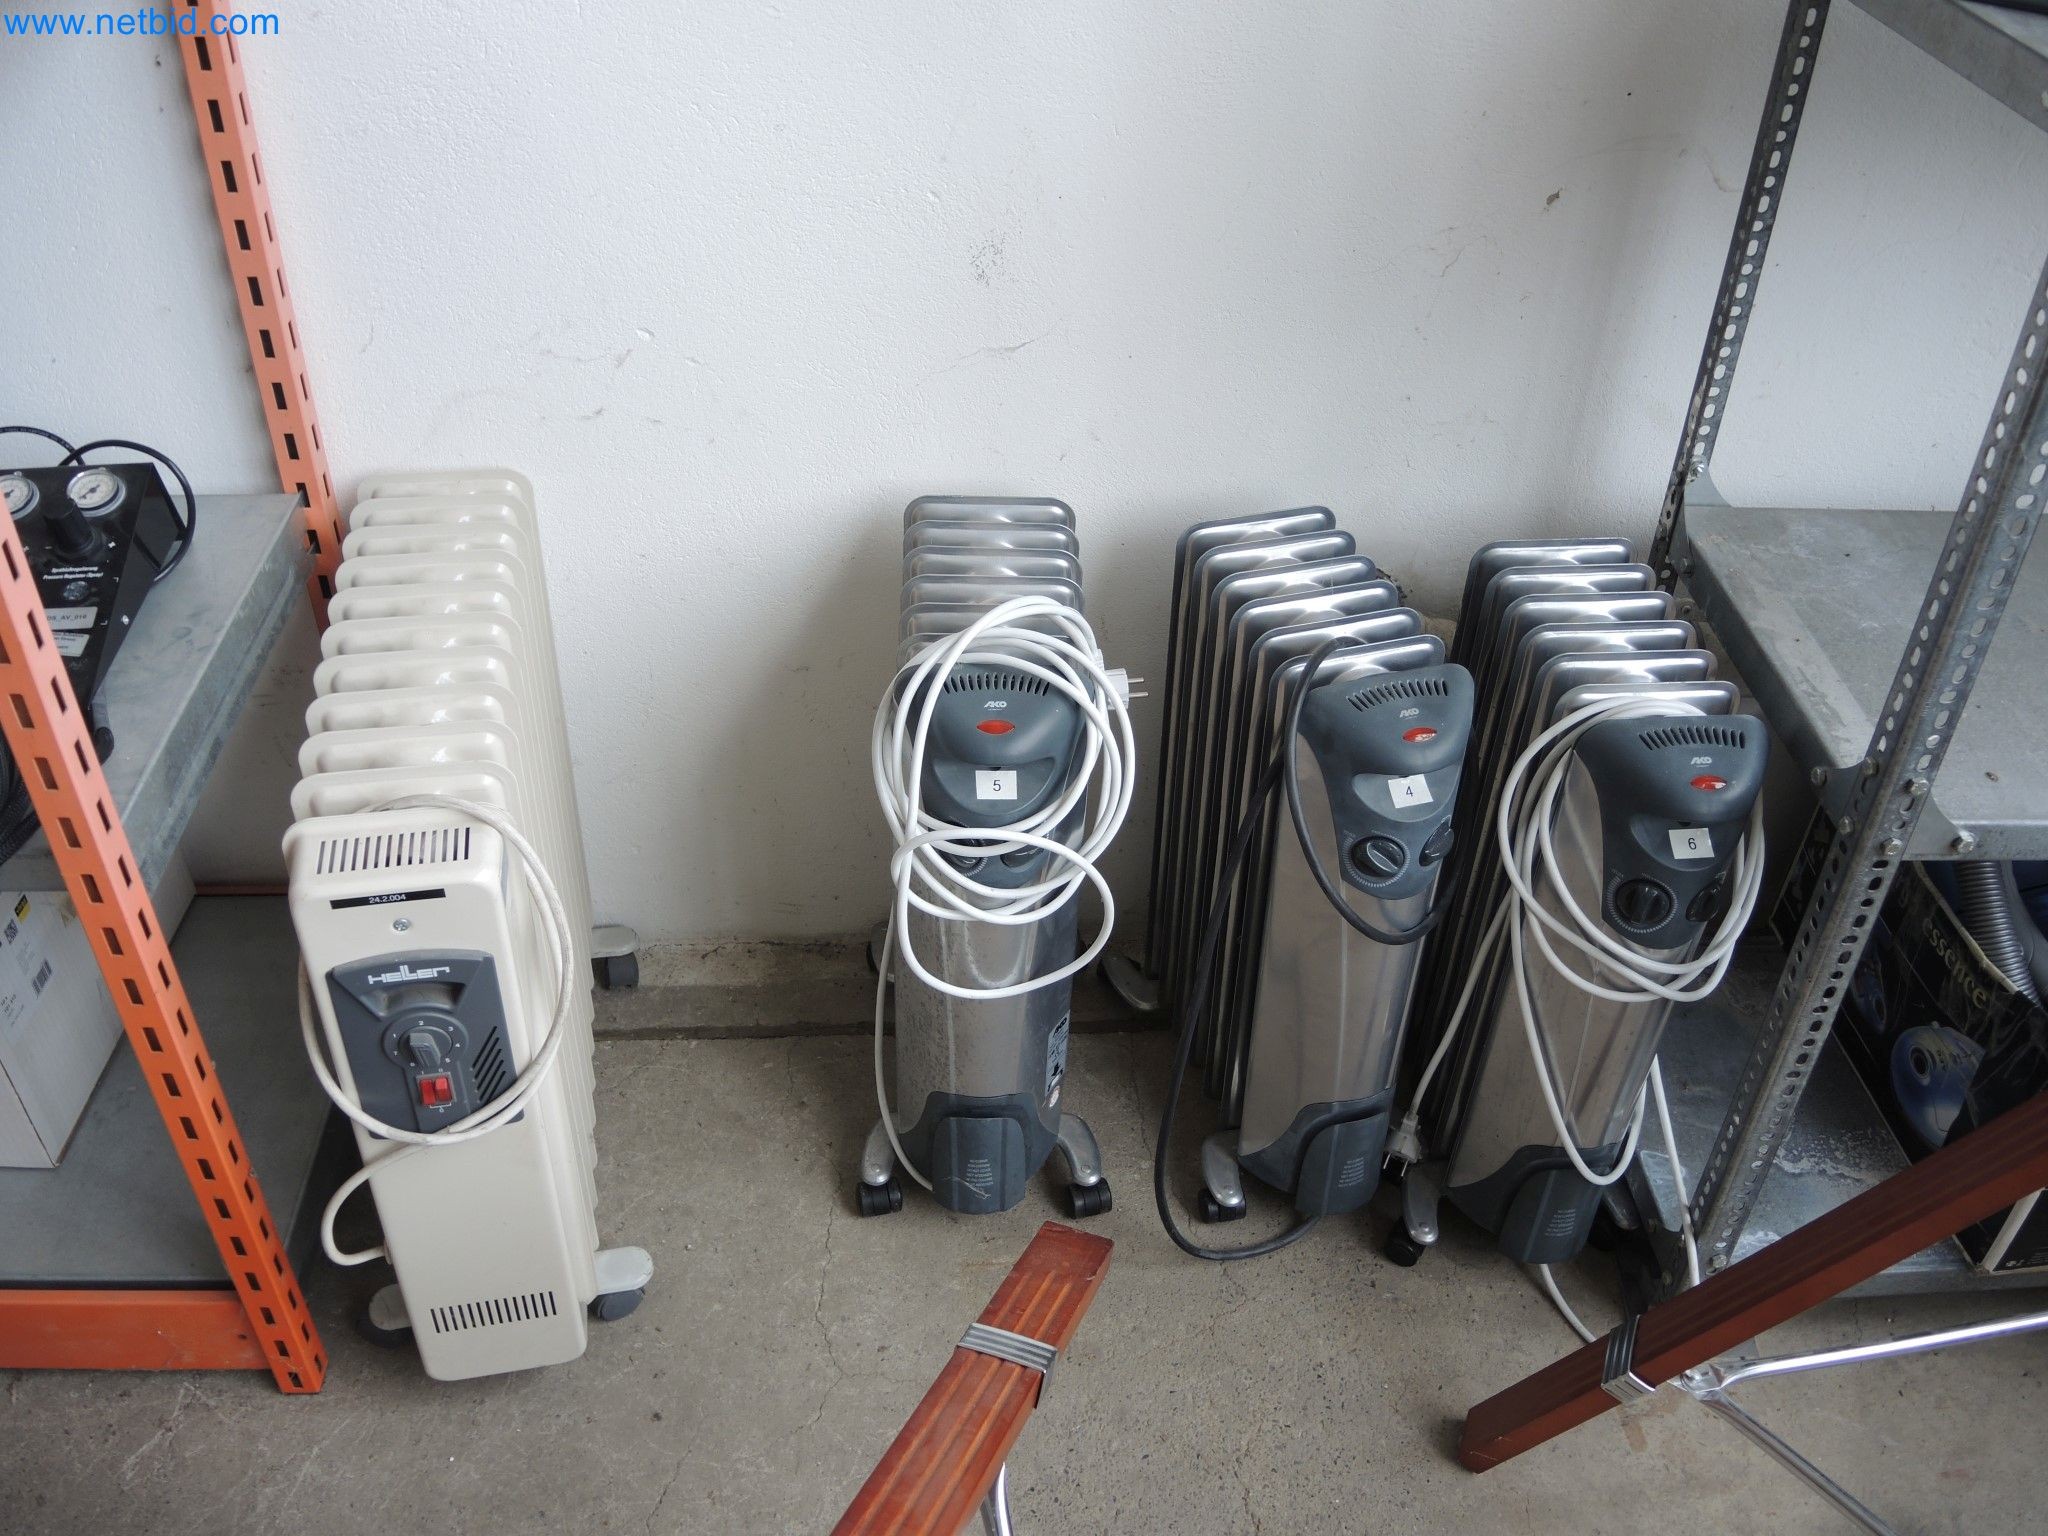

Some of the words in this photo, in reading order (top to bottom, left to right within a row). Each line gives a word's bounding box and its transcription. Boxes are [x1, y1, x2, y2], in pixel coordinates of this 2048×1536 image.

[1399, 707, 1420, 718] AKO
[1690, 756, 1713, 765] AKO
[993, 779, 1002, 792] 5
[1406, 786, 1413, 797] 4
[1688, 837, 1697, 850] 6
[368, 893, 406, 904] 24.2.004
[1922, 918, 1987, 1009] essence
